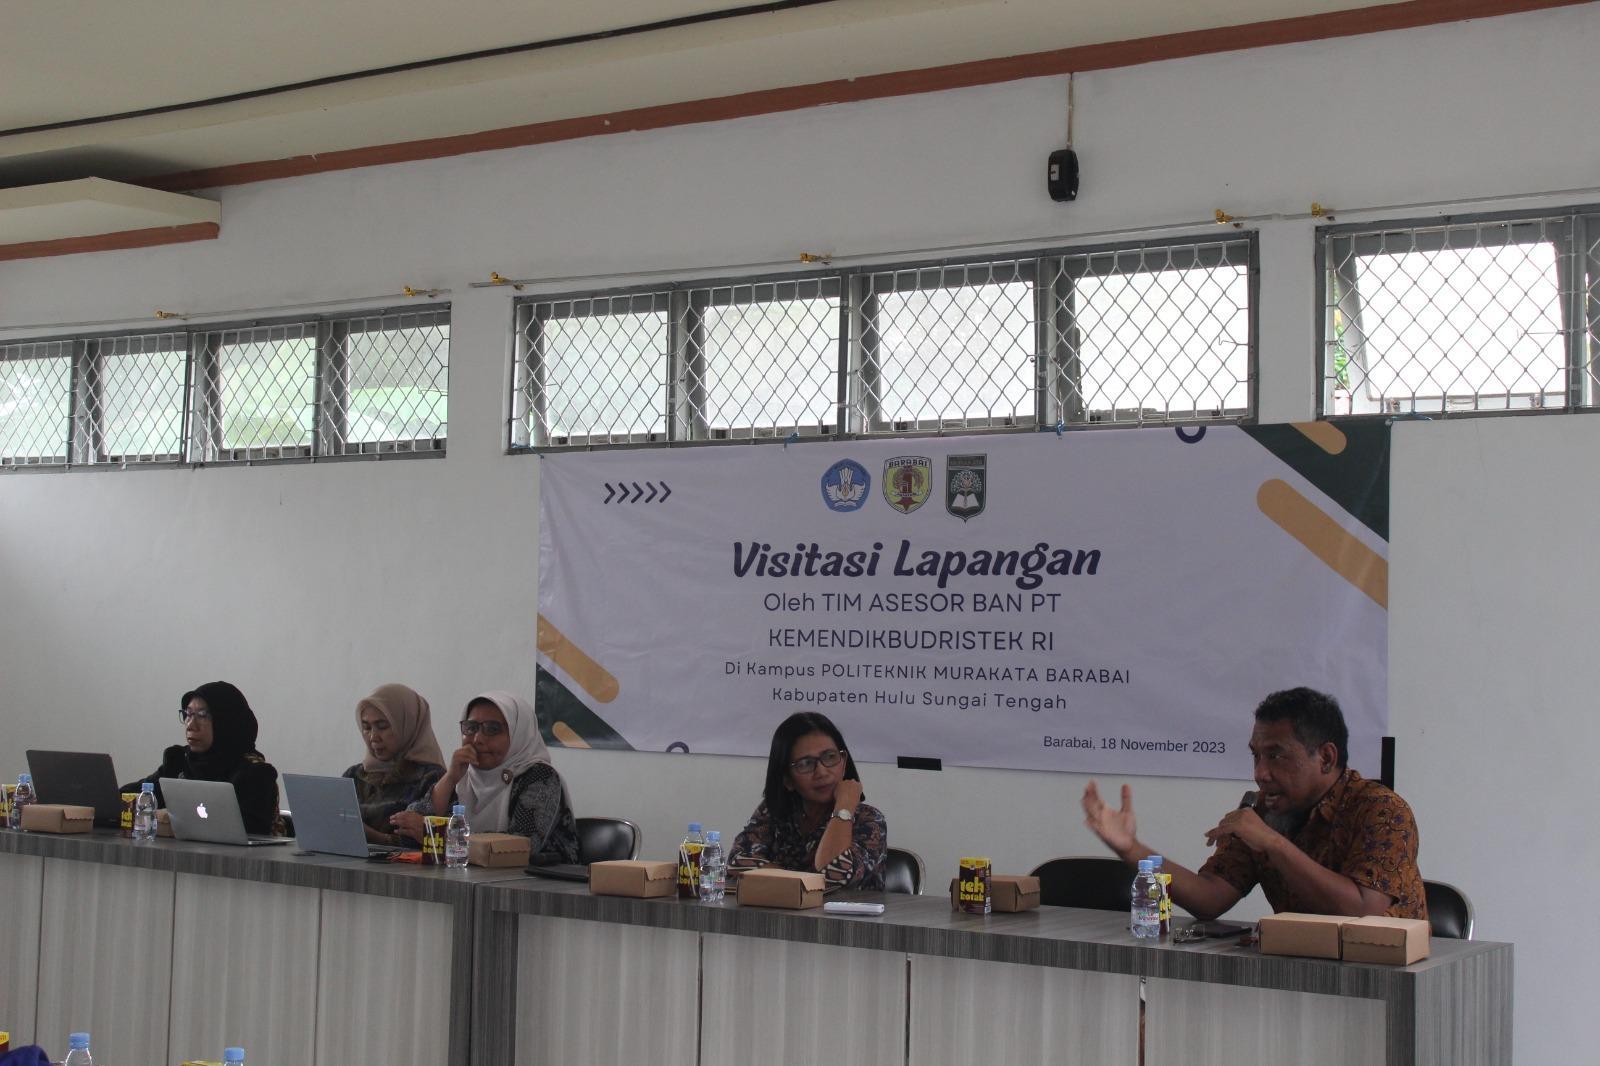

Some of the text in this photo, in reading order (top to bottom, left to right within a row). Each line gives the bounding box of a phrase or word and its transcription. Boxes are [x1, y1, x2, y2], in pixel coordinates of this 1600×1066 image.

[889, 458, 928, 468] BARABAI
[733, 539, 1101, 591] Visitasi Lapangan
[763, 592, 1062, 613] Oleh TIM ASESOR BAN PT
[769, 628, 1054, 652] KEMENDIKBUDRISTEK RI
[725, 661, 1130, 684] Di Kampus POLITEKNIK MURAKATA BARABAI
[772, 687, 1067, 713] Kabupaten Hulu Sungai Tengah
[1043, 735, 1226, 754] Barabai, 18 November 2023
[960, 876, 985, 893] teh
